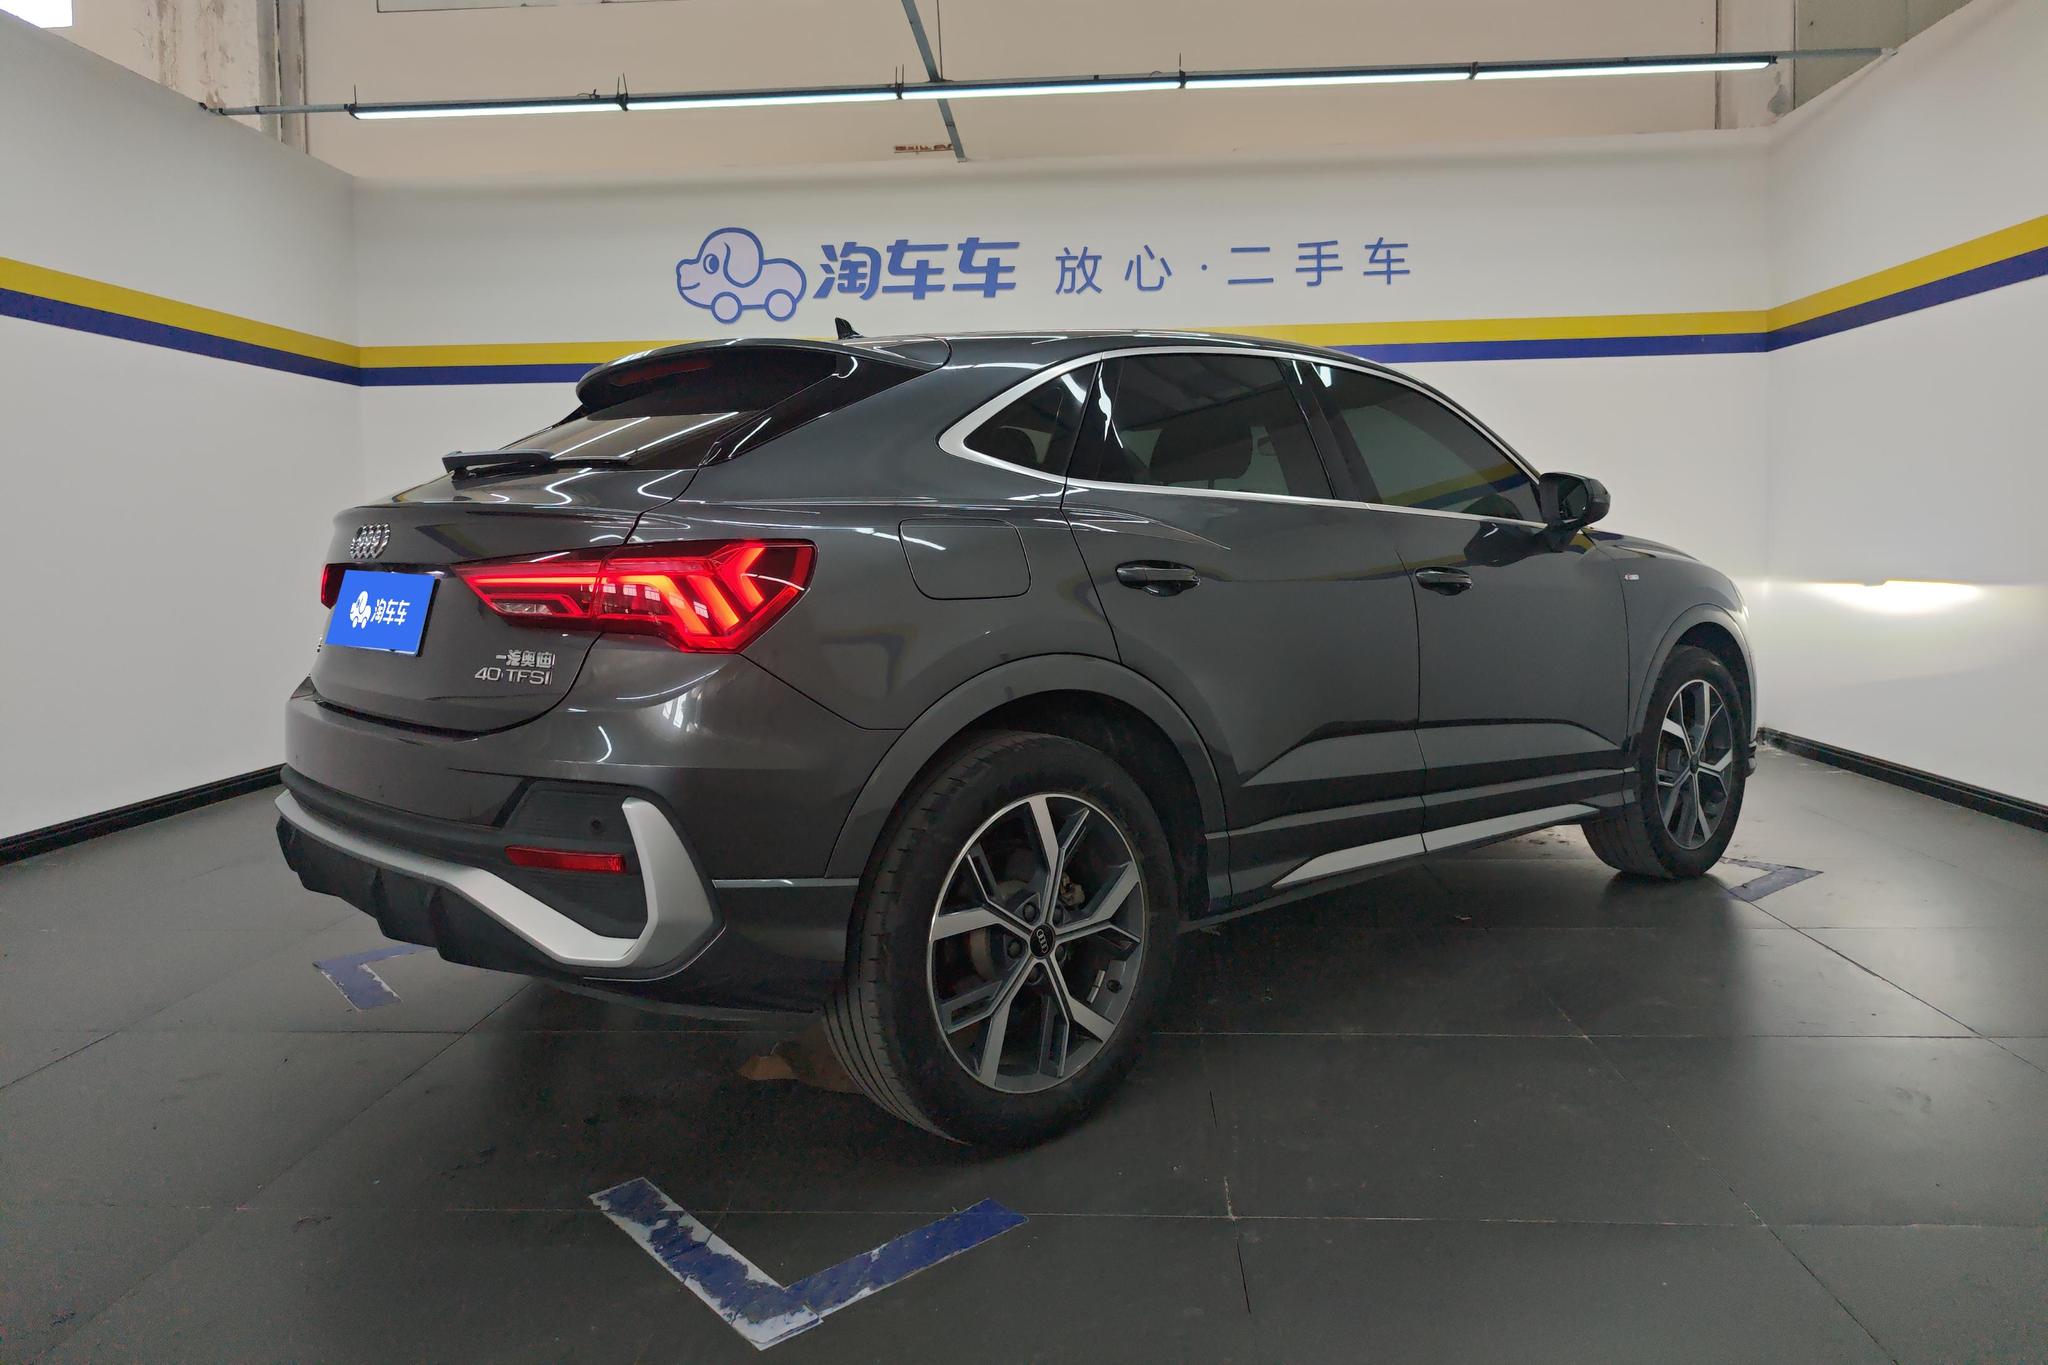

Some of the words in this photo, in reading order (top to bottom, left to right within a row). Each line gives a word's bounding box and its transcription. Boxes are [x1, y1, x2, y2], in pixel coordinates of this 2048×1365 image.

[813, 236, 1020, 300] 淘车车
[474, 667, 501, 681] 40
[506, 668, 552, 686] TFSI
